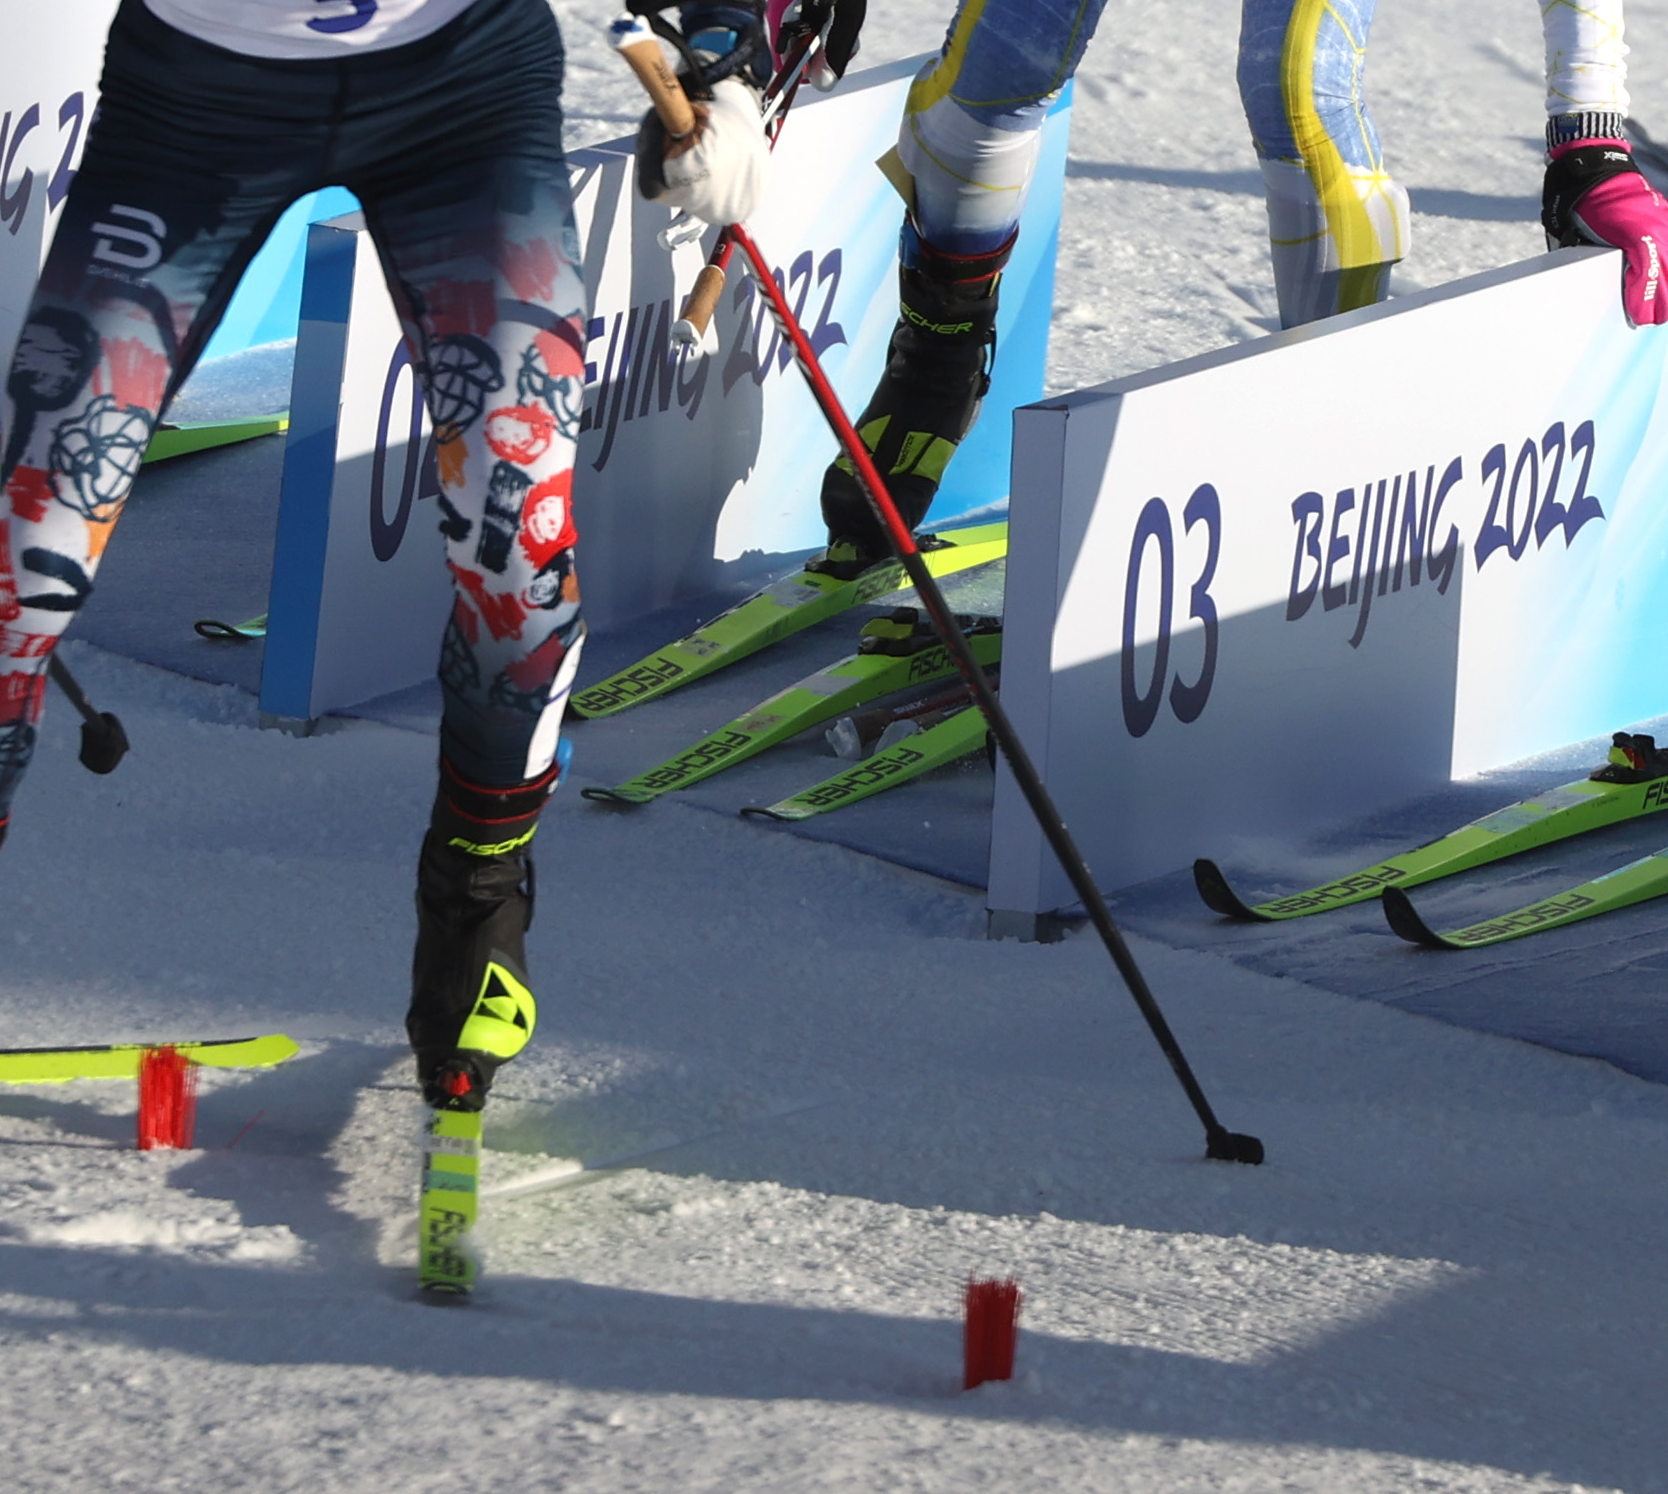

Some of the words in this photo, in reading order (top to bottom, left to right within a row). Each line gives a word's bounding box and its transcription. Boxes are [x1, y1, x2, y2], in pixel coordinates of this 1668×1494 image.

[900, 301, 975, 334] SCHER
[369, 332, 440, 563] 0
[577, 296, 710, 473] EIJING
[722, 248, 849, 398] 2022
[1120, 482, 1223, 739] 03
[1285, 455, 1464, 650] BEIJING
[1473, 419, 1607, 574] 2022
[577, 657, 684, 712] FISCHER
[632, 730, 752, 789] FISCHER
[796, 746, 925, 807] FISCHER
[1269, 864, 1407, 915] FISCHER
[1457, 892, 1596, 944] FISCHER
